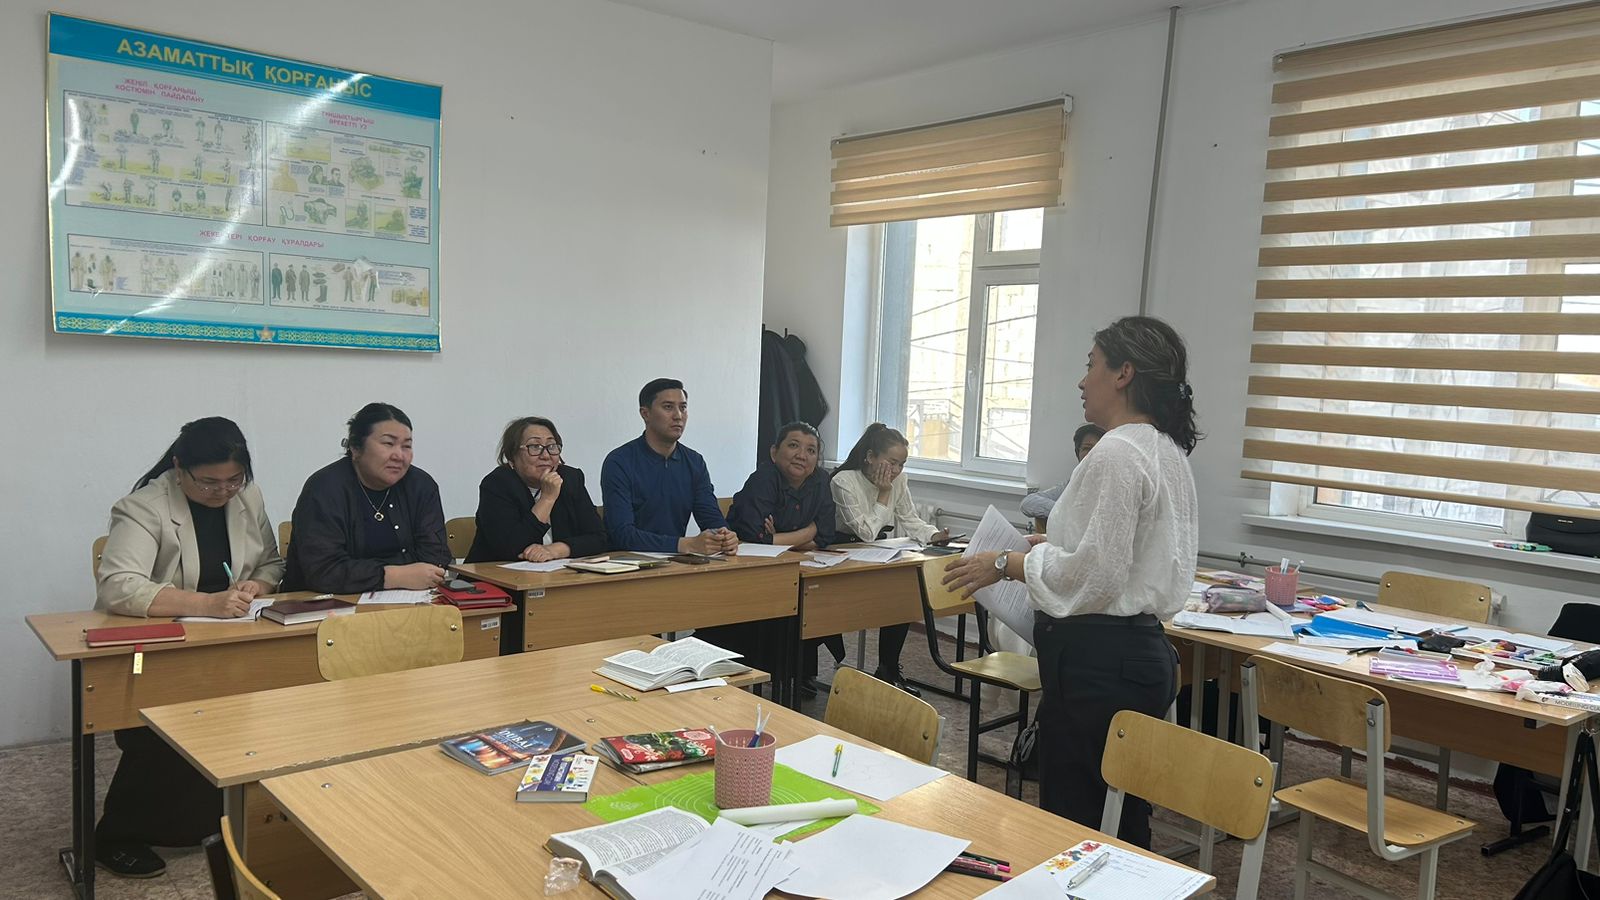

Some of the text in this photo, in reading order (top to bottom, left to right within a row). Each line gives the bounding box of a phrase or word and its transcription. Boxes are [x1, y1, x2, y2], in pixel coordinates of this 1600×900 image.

[116, 38, 373, 98] АЗАМАТТЫҚ ҚОРҒАНЫС
[498, 730, 534, 749] DUBAI
